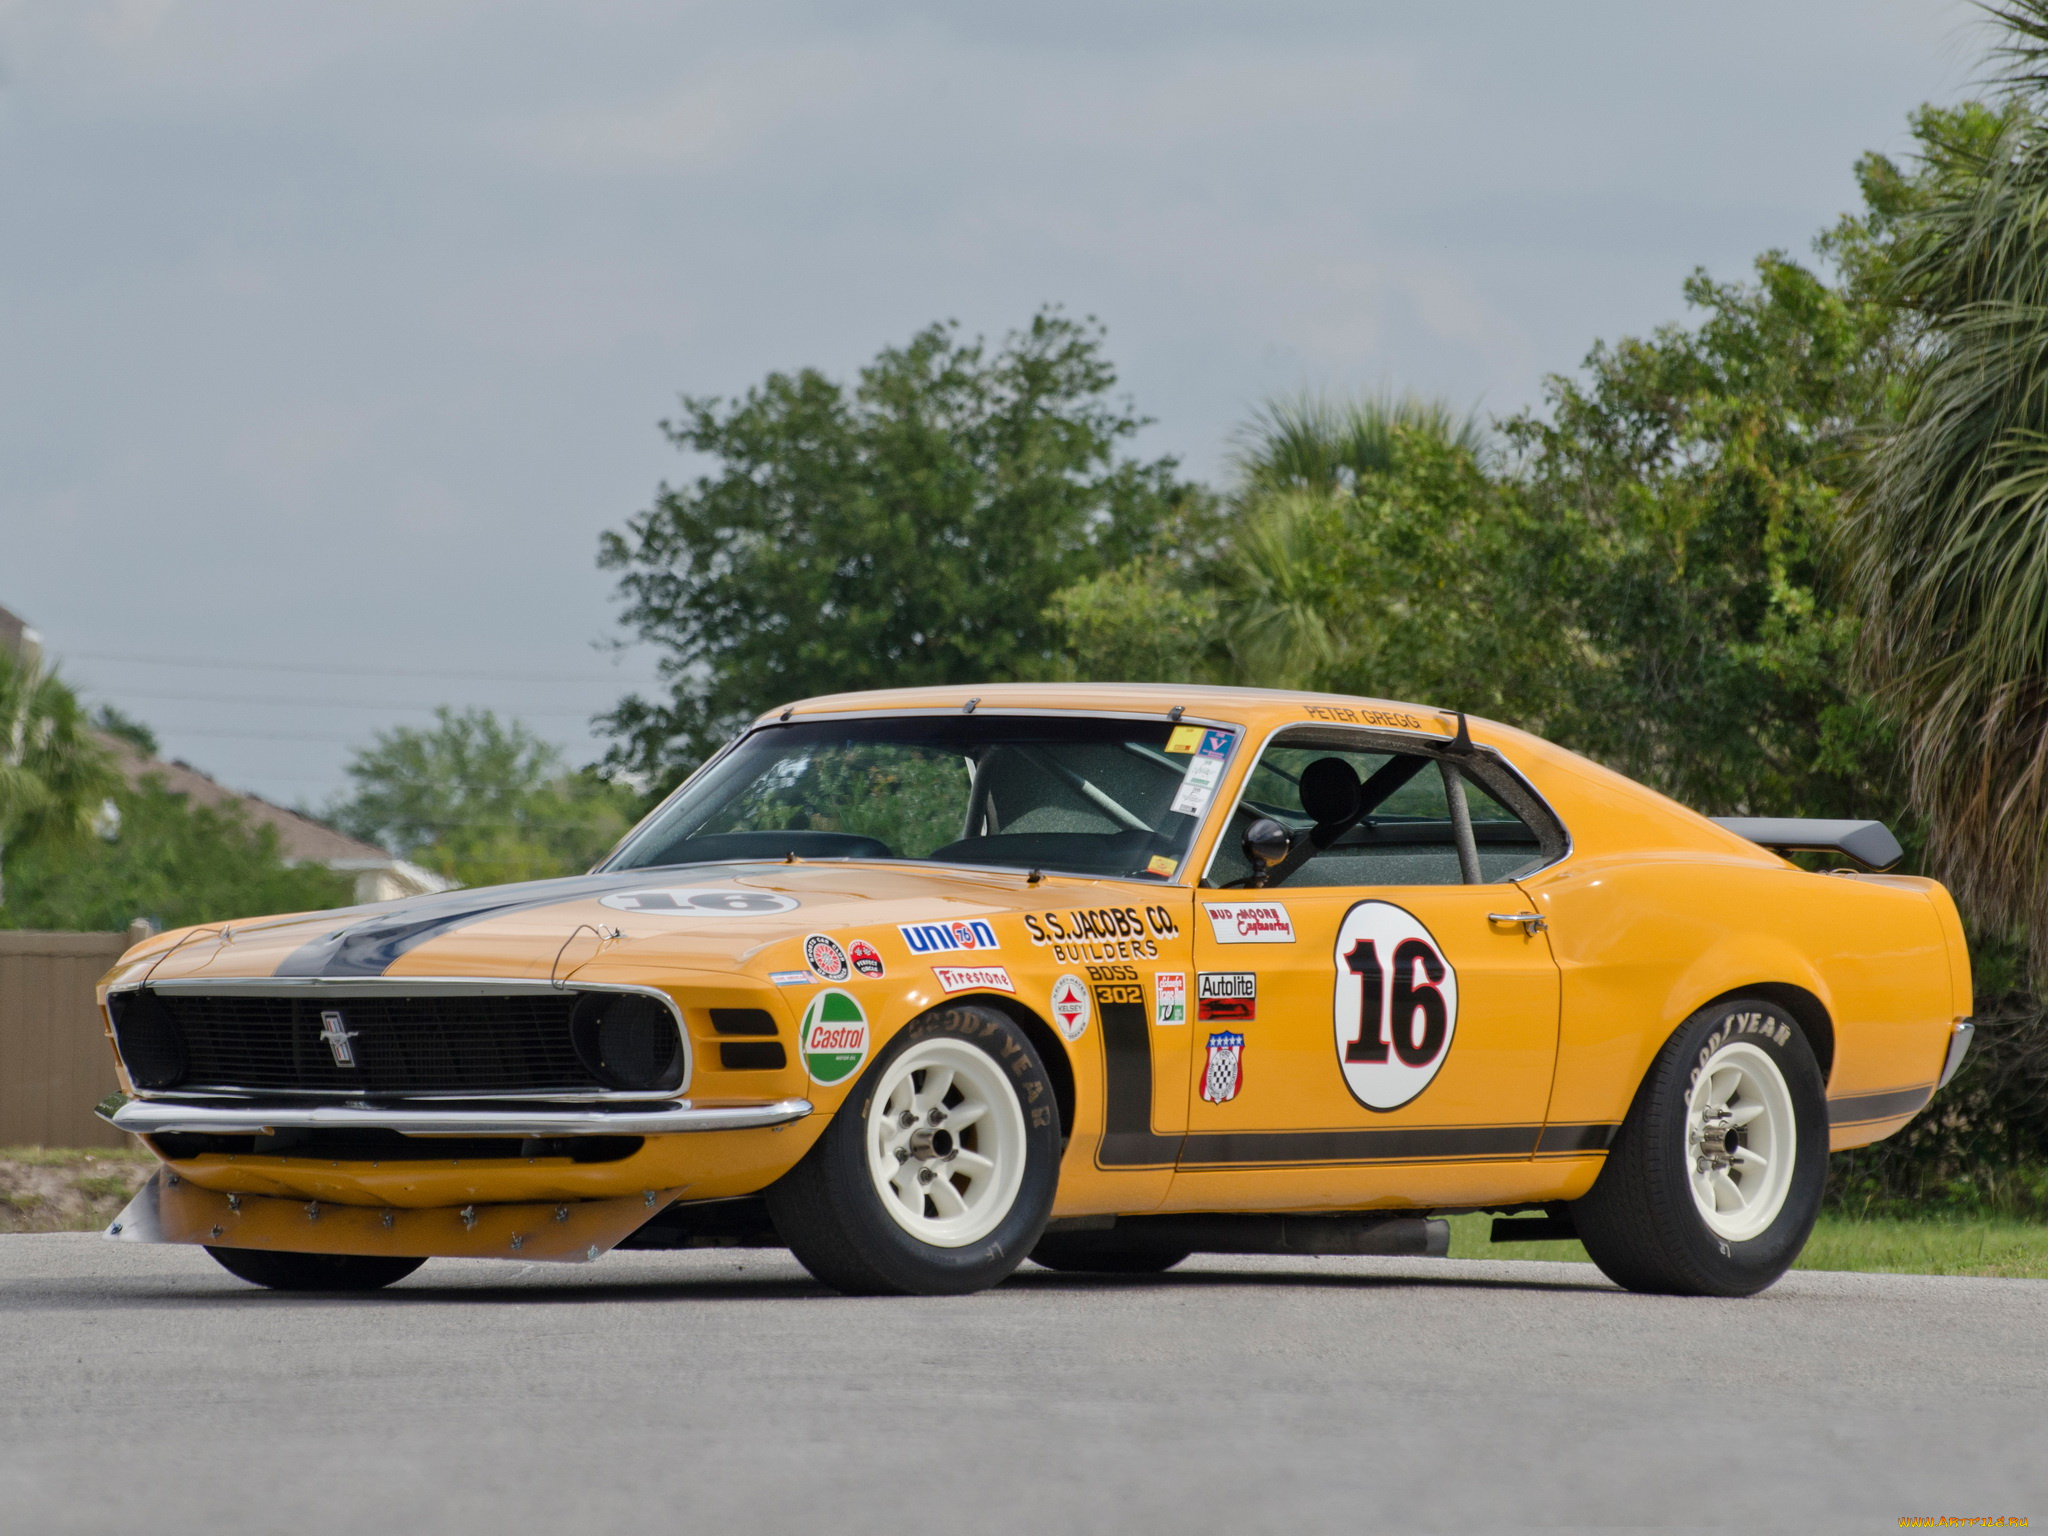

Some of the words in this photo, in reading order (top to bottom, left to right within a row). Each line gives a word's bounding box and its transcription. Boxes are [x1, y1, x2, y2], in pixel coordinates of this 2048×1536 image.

[1303, 705, 1360, 723] PETER
[1361, 710, 1422, 729] GREGG
[615, 892, 784, 911] 16
[1146, 905, 1179, 938] CO.
[1209, 909, 1232, 919] BUD
[956, 928, 972, 942] 76
[1054, 940, 1159, 962] BUILDERS
[939, 969, 1009, 988] Firestone
[1085, 965, 1139, 982] BOSS
[1097, 986, 1142, 1004] 302
[1202, 976, 1253, 996] Autolite
[1343, 937, 1447, 1069] 16
[811, 1026, 864, 1049] Castrol
